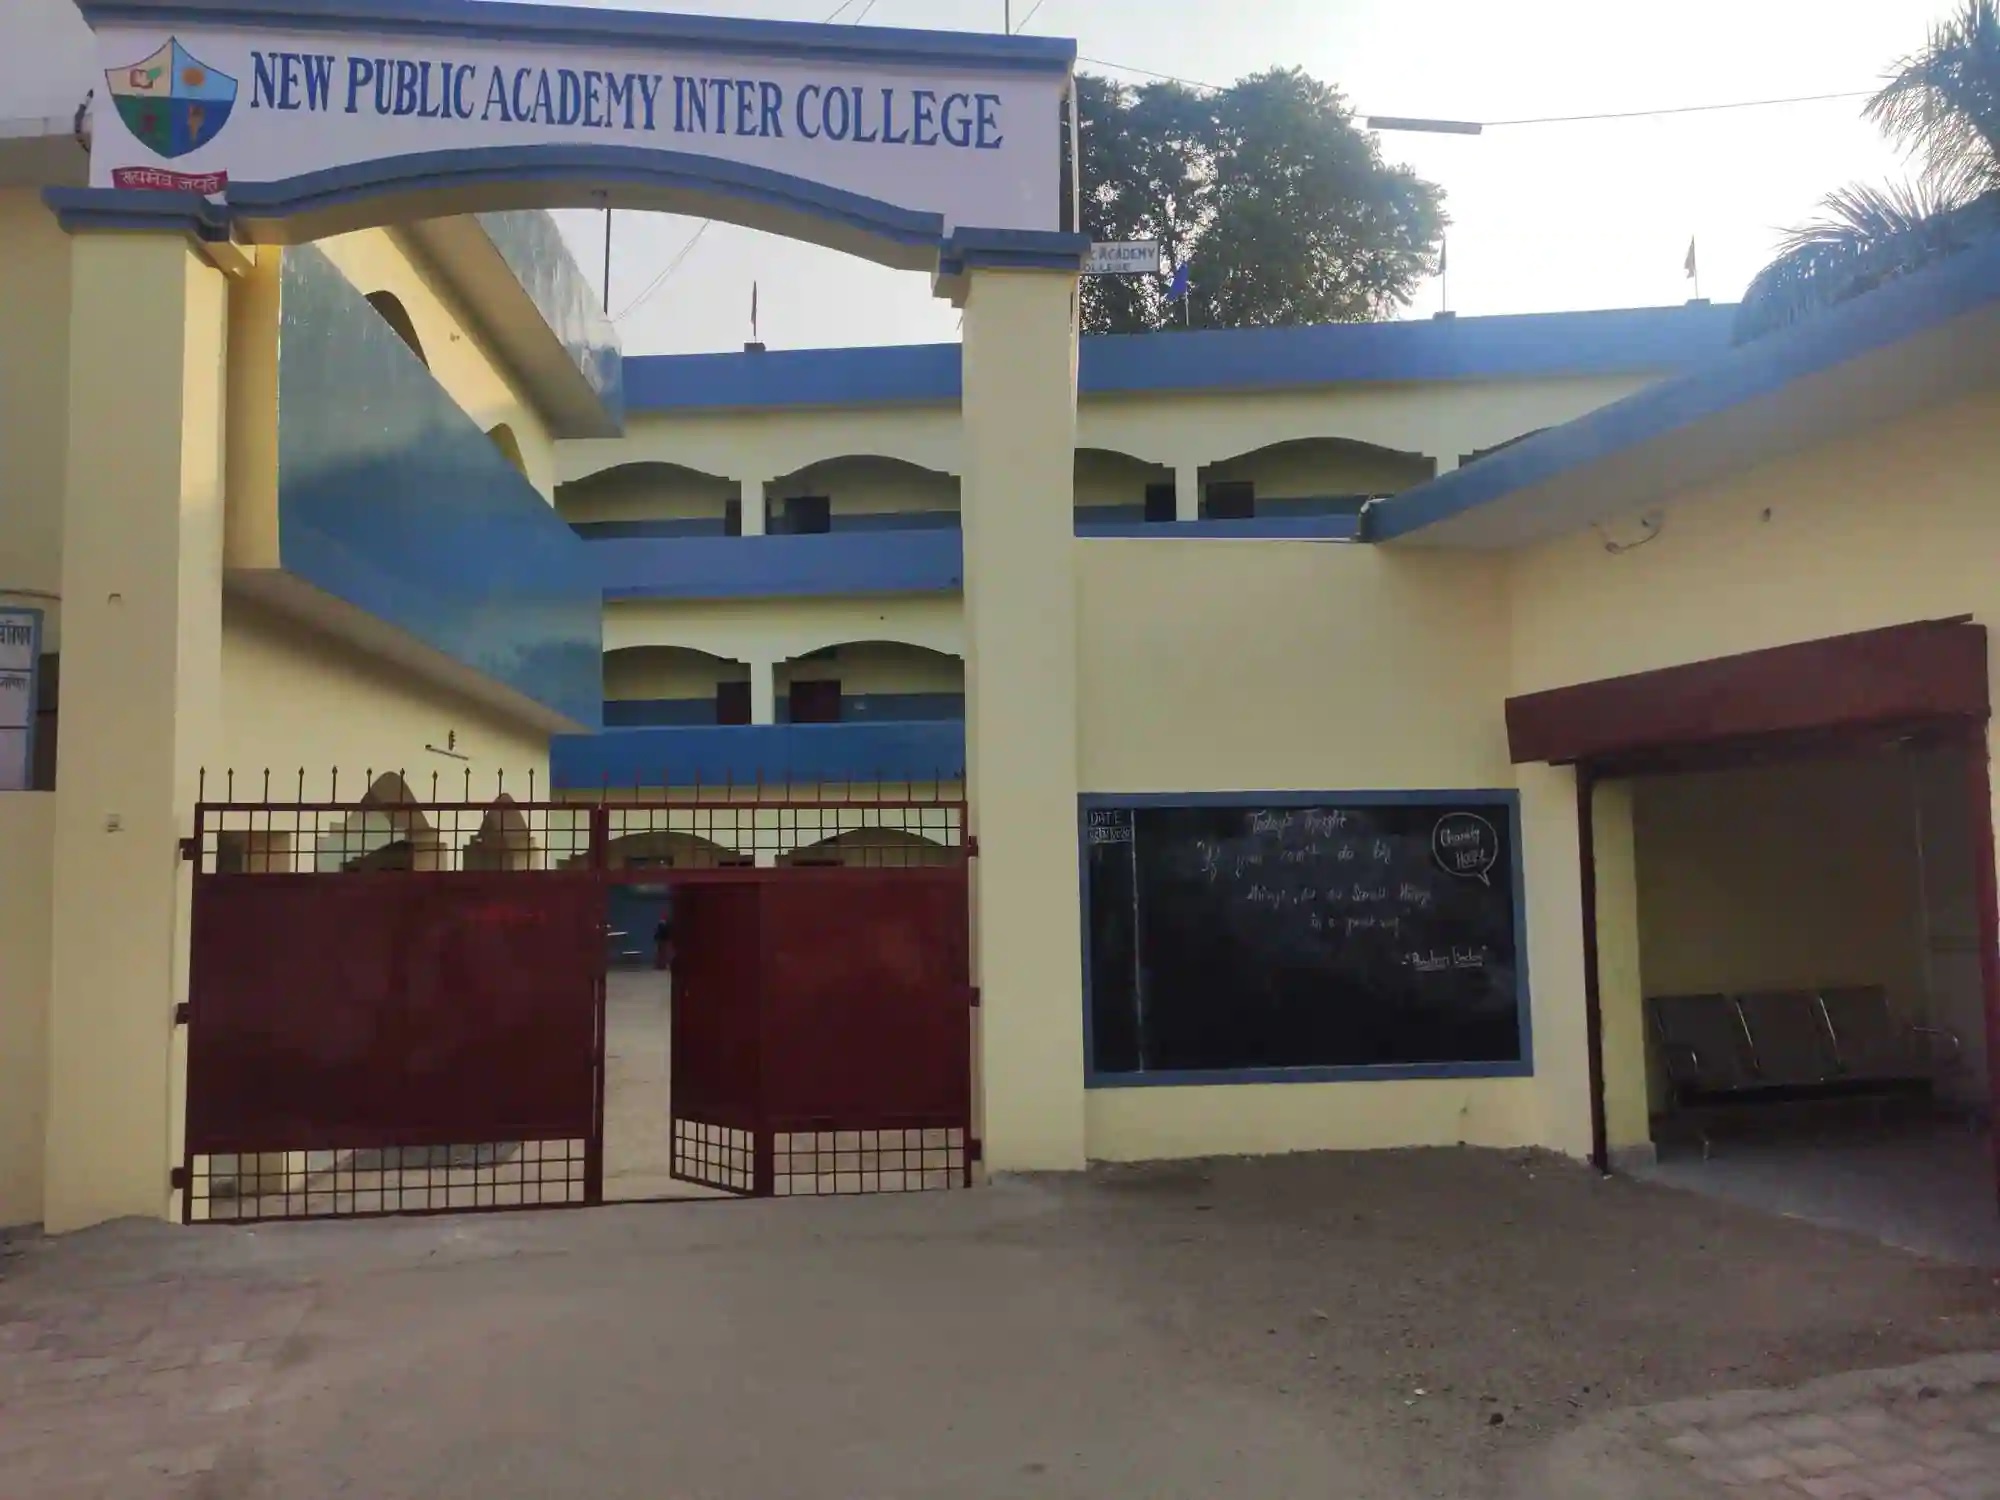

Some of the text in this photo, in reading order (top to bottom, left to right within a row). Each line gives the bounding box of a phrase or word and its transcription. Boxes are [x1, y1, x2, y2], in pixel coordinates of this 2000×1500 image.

[250, 51, 1004, 150] NEW PUBLIC ACADEMY INTER COLLEGE
